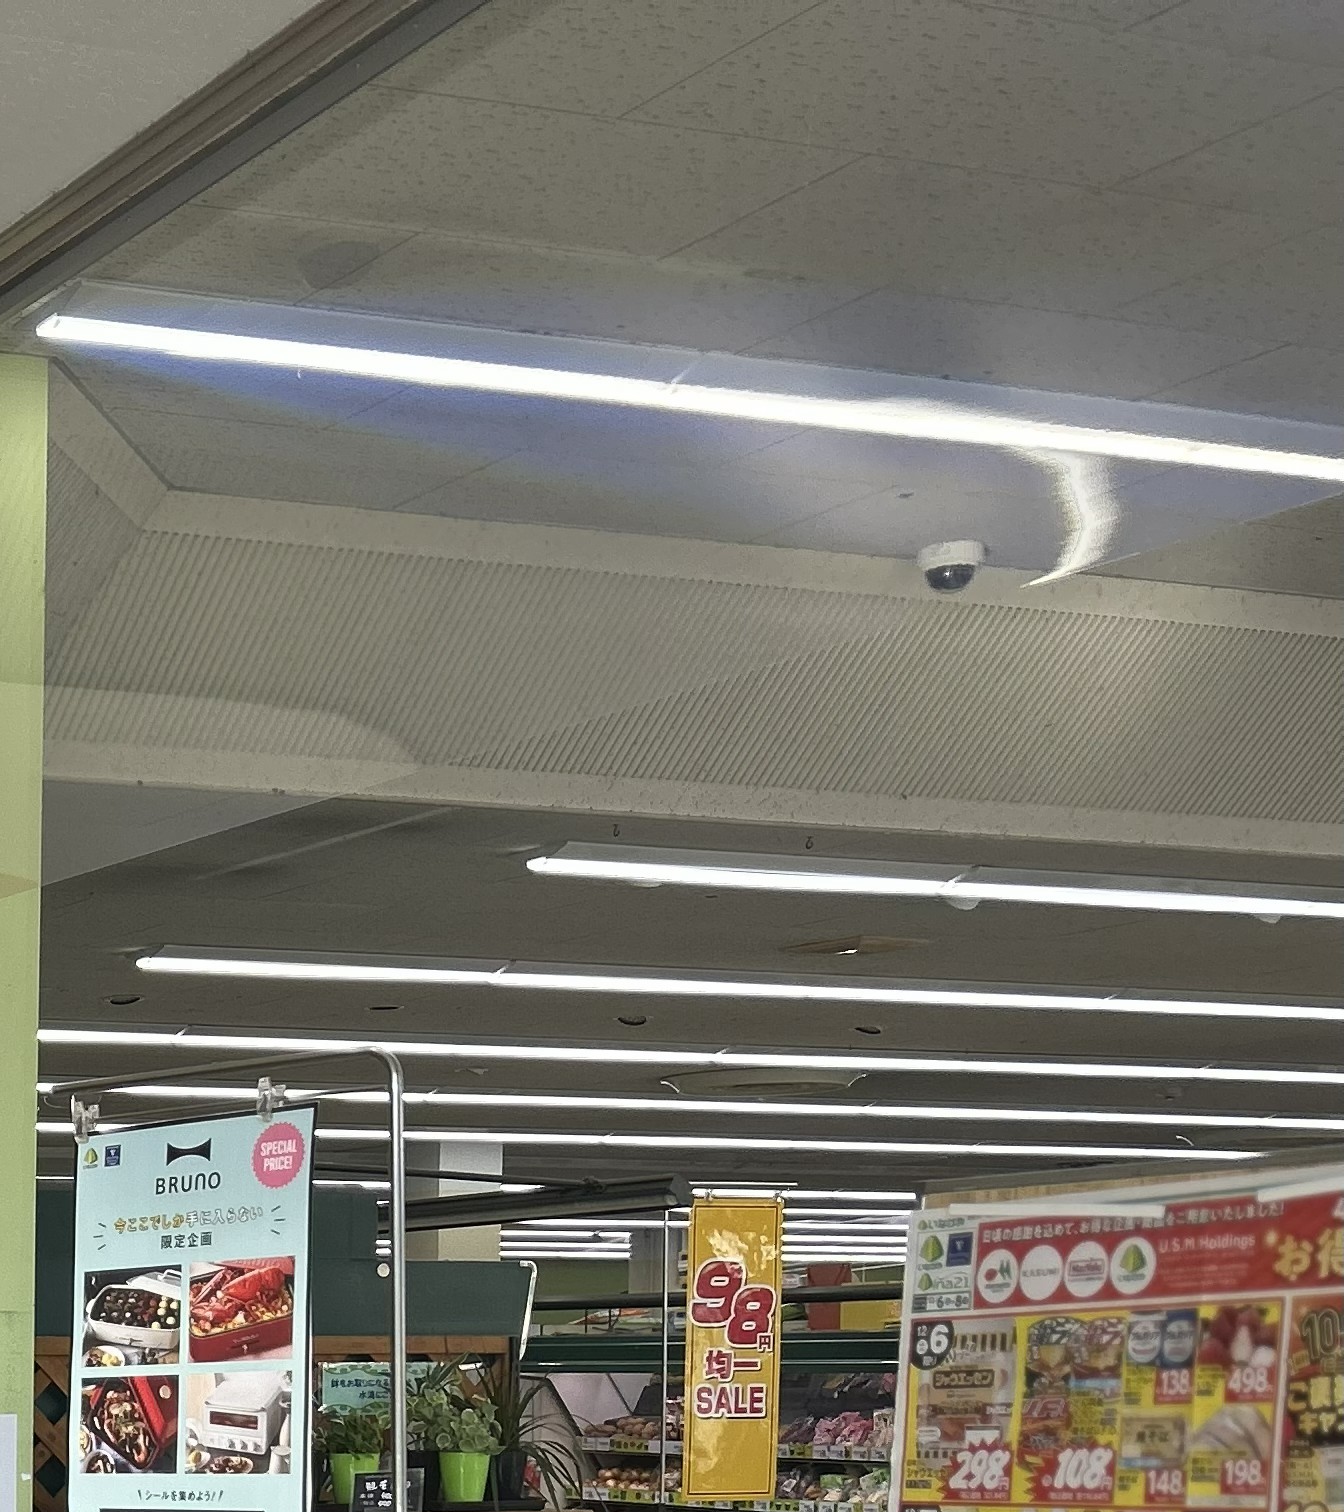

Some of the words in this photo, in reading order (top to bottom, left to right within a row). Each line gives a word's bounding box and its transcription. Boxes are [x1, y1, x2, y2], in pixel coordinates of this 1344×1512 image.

[260, 1139, 297, 1157] SPECIAL
[263, 1156, 293, 1172] PRICE!
[155, 1172, 221, 1195] BRUNO
[114, 1206, 262, 1234] 今ここでしか手に入らない
[161, 1231, 212, 1249] 限定企画
[1200, 1234, 1256, 1249] Holdings
[691, 1260, 776, 1347] 98
[758, 1333, 773, 1350] 円
[931, 1324, 949, 1353] 6
[705, 1350, 760, 1380] 均一
[935, 1372, 991, 1386] シャウエッセン
[1161, 1369, 1190, 1395] 138
[1228, 1367, 1268, 1393] 498
[696, 1385, 766, 1417] SALE
[1148, 1470, 1183, 1494] 148
[1225, 1460, 1262, 1485] 198
